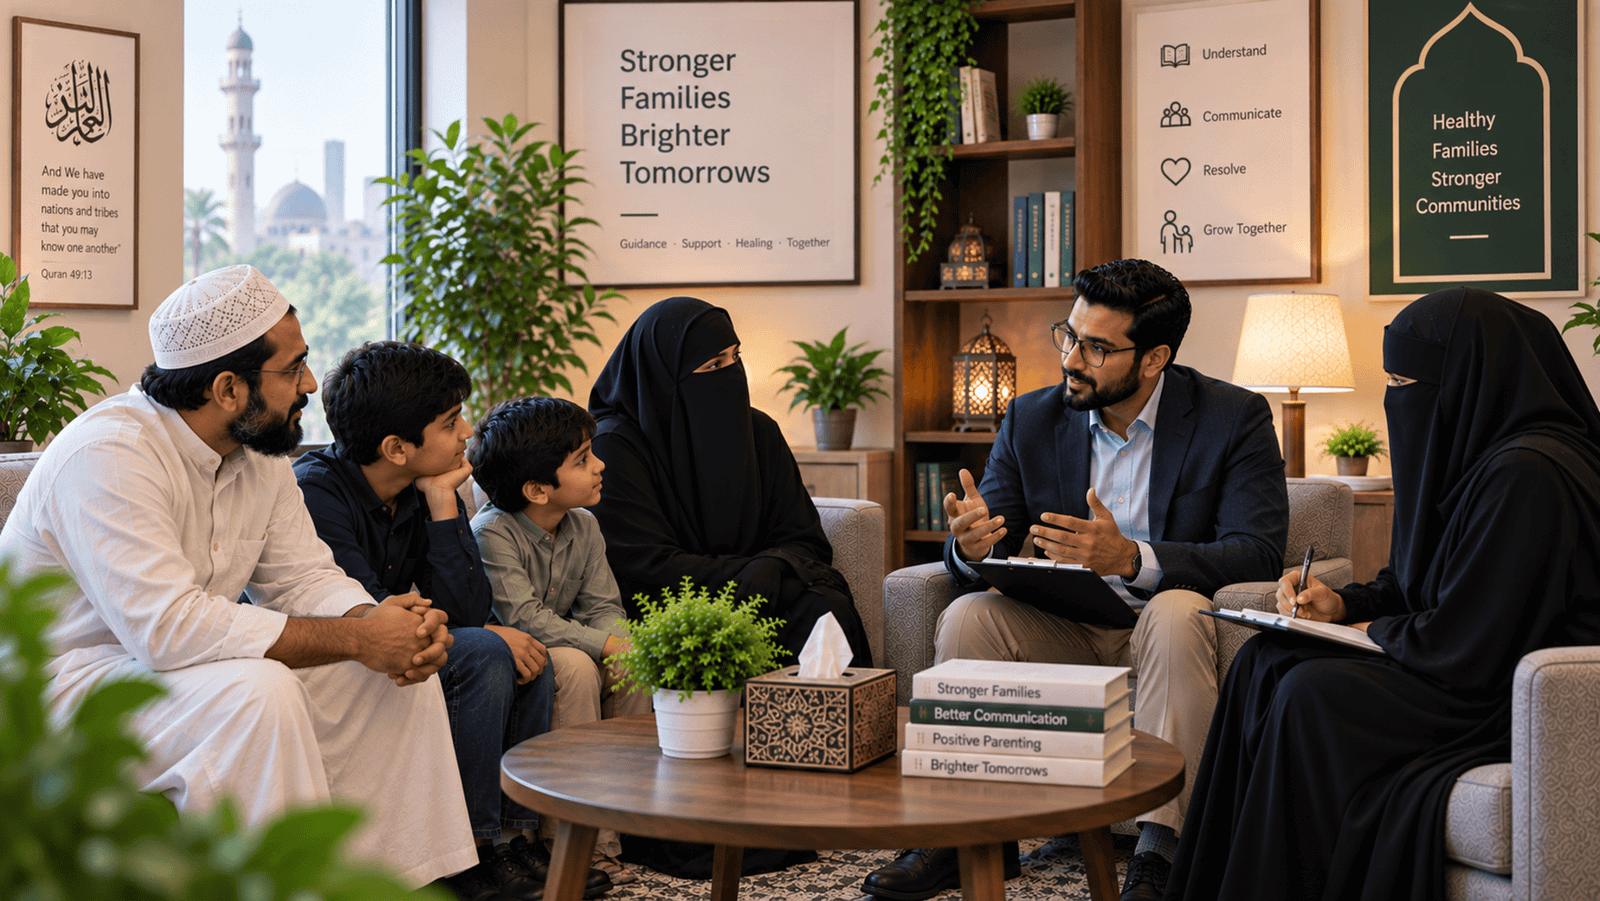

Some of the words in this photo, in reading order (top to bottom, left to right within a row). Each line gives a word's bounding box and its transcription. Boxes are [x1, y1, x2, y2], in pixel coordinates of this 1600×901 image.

[1202, 44, 1267, 60] Understand
[620, 49, 736, 78] Stronger
[621, 85, 731, 109] Families
[1202, 107, 1282, 123] Communicate
[1433, 110, 1496, 131] Healthy
[621, 123, 730, 153] Brighter
[1432, 141, 1498, 159] Families
[41, 165, 62, 178] And
[64, 166, 80, 179] We
[83, 168, 105, 181] have
[620, 161, 770, 184] Tomorrows
[1203, 163, 1247, 176] Resolve
[1431, 170, 1502, 189] Stronger
[41, 185, 69, 197] made
[71, 188, 89, 200] you
[92, 187, 110, 199] into
[41, 204, 73, 216] nations
[76, 206, 92, 217] and
[94, 206, 119, 218] tribes
[1415, 195, 1521, 214] Communities
[41, 223, 59, 234] that
[62, 226, 78, 236] you
[80, 226, 99, 238] may
[1203, 223, 1233, 236] Grow
[1236, 222, 1287, 237] Together
[41, 240, 65, 252] know
[67, 243, 83, 253] one
[620, 239, 667, 249] Guidance
[682, 238, 722, 251] Support
[735, 238, 773, 250] Healing
[787, 237, 830, 250] Together
[41, 268, 67, 280] Quran
[70, 269, 92, 280] 49:13
[937, 682, 989, 699] Stronger
[992, 685, 1041, 699] Families
[934, 706, 971, 721] Better
[973, 708, 1068, 726] Communication
[933, 732, 980, 747] Positive
[983, 736, 1042, 752] Parenting
[931, 758, 979, 775] Brighter
[982, 761, 1048, 777] Tomorrows
